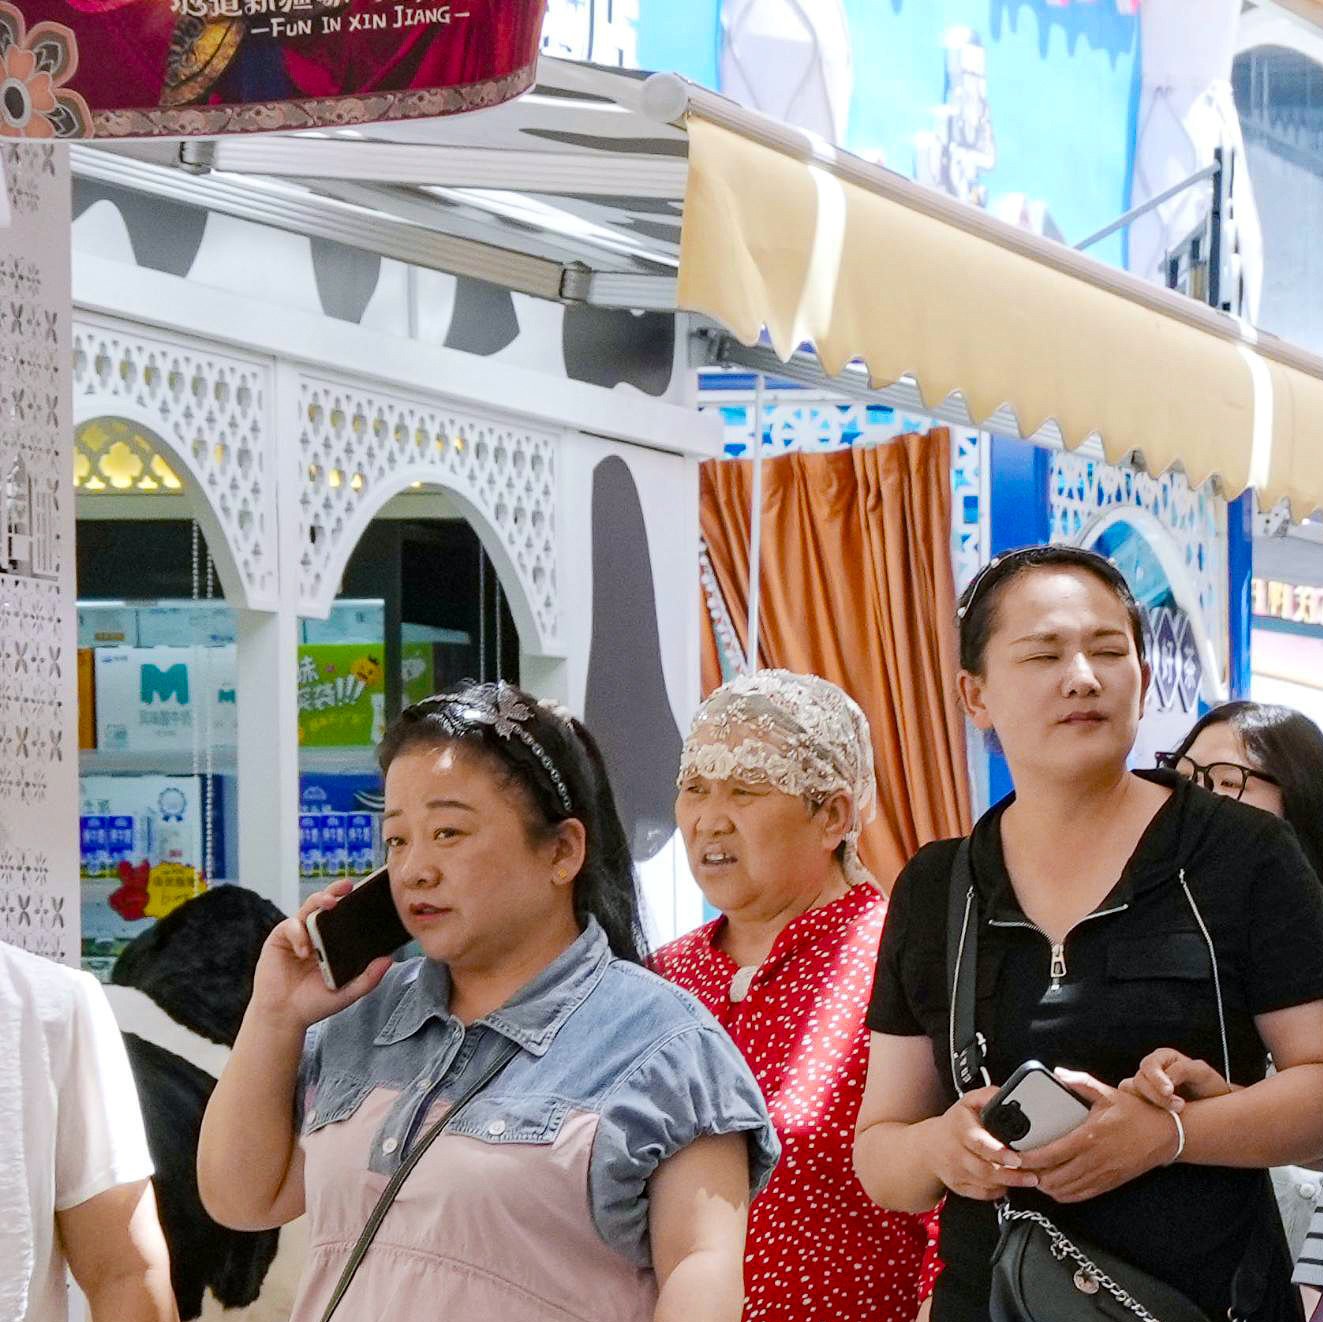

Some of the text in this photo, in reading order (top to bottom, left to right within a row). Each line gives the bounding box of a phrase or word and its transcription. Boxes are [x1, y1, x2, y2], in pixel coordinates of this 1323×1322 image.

[321, 16, 342, 34] IN
[348, 13, 387, 31] XIN
[392, 5, 451, 28] JIANG
